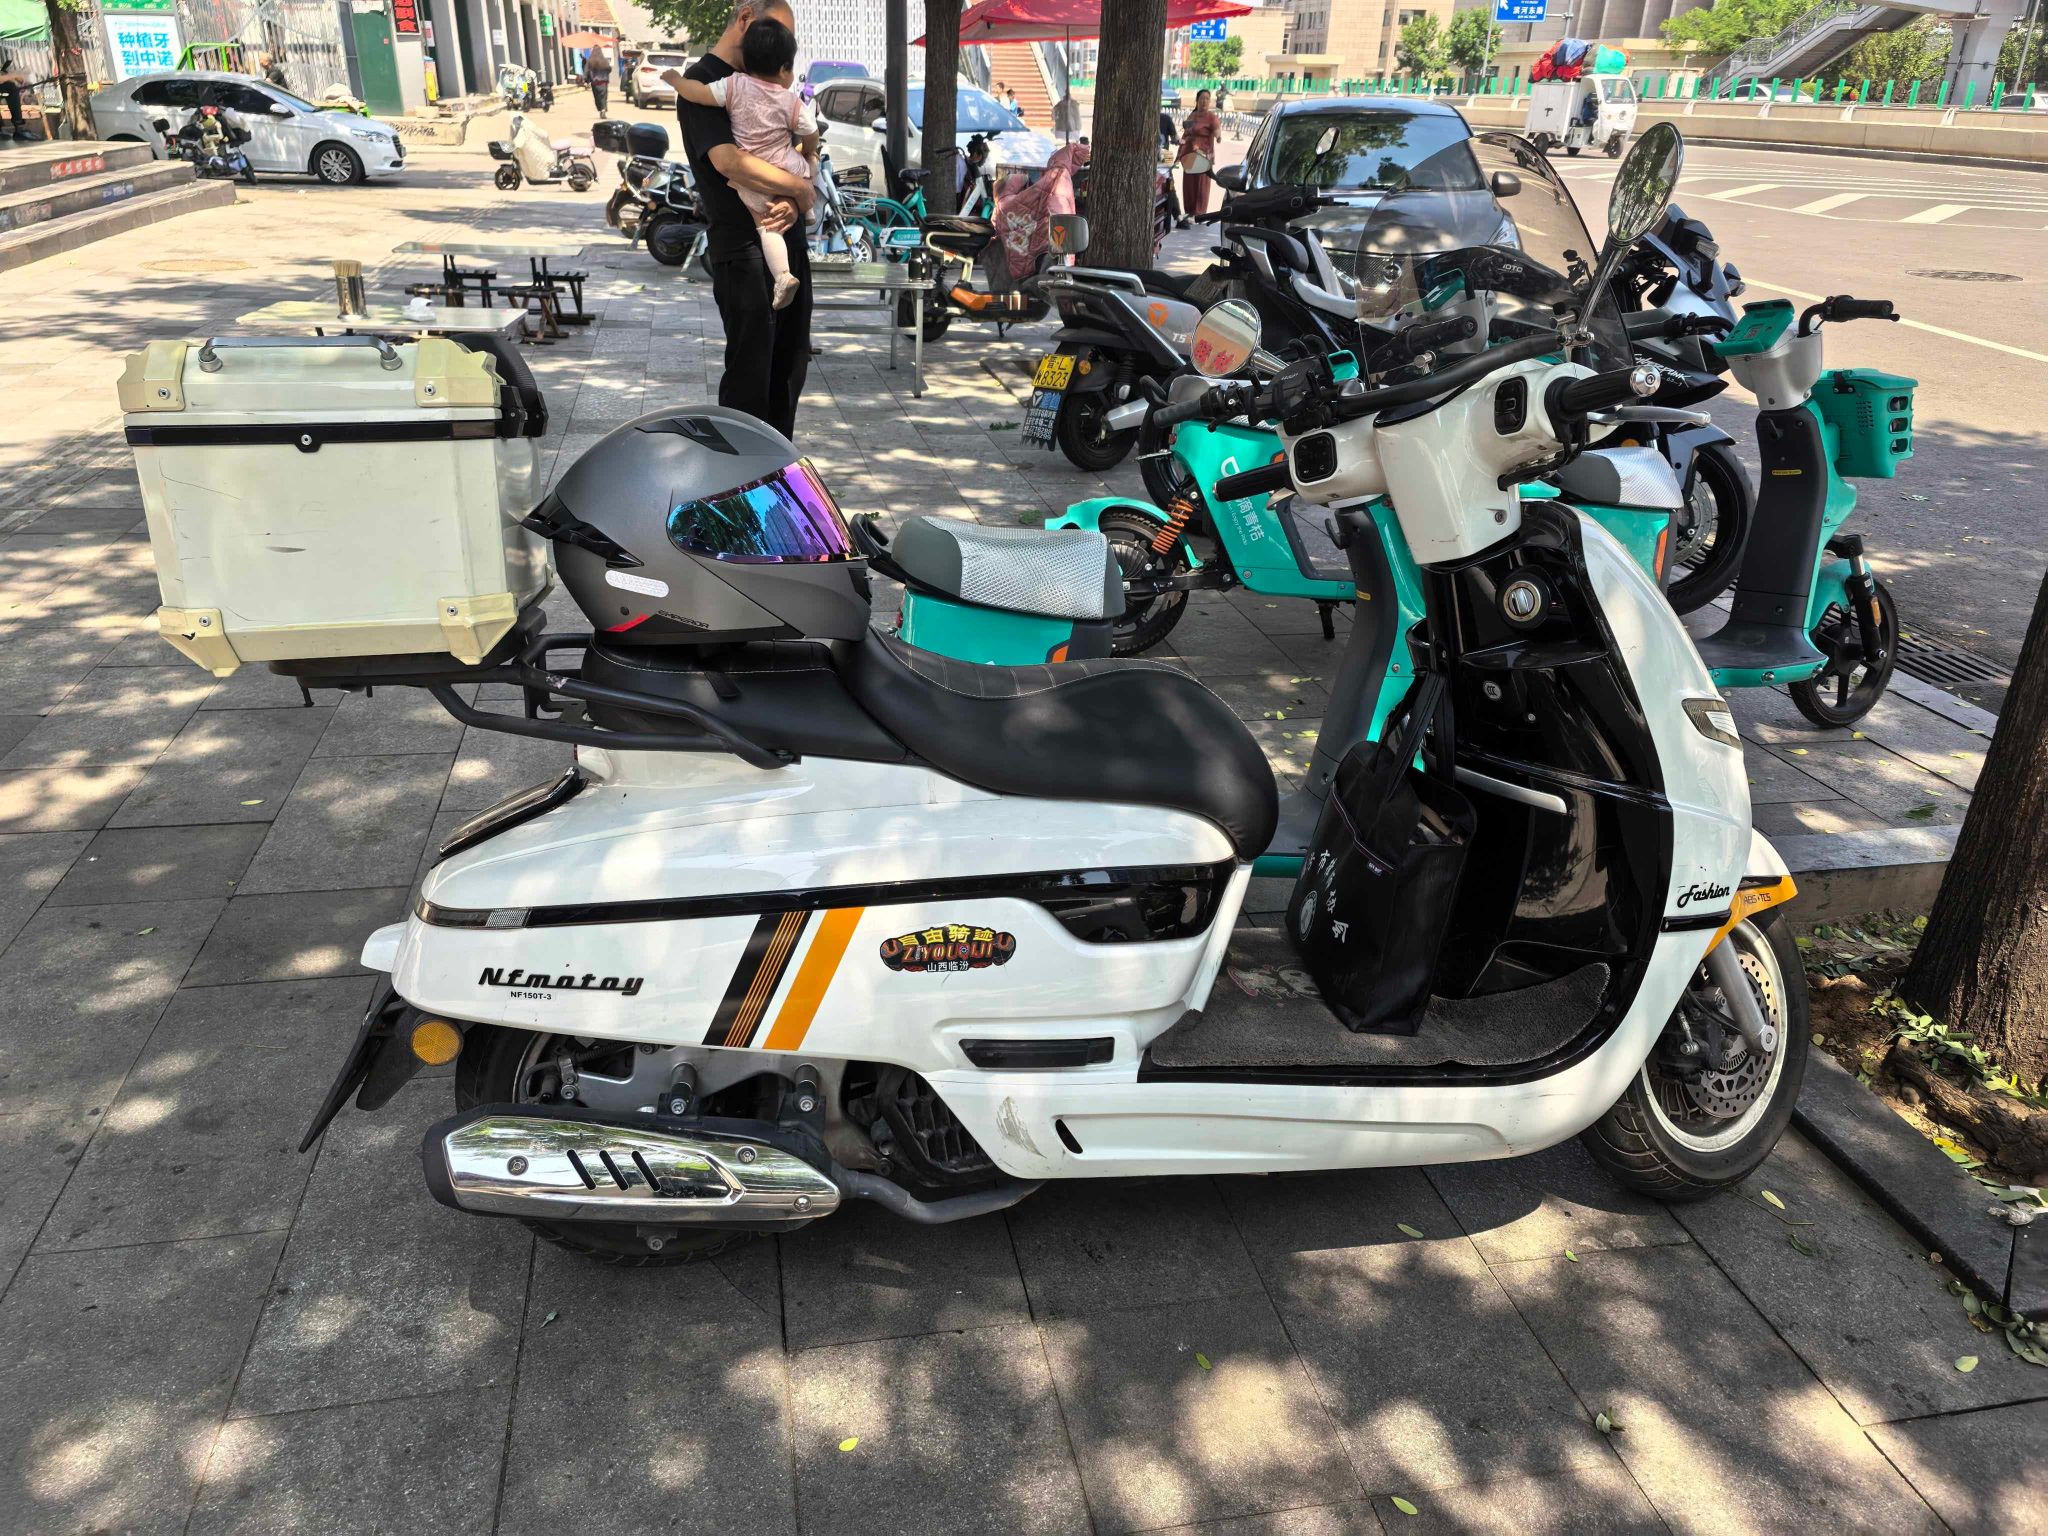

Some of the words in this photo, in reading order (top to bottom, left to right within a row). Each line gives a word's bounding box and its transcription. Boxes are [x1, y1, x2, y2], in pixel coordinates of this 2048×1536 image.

[1513, 6, 1544, 15] 滨河东路
[117, 32, 170, 48] 种植牙
[121, 50, 174, 66] 到中诺
[1677, 883, 1730, 908] Fashion
[898, 925, 996, 945] 自由骑迹
[927, 960, 969, 972] 山西临汾
[510, 991, 552, 1000] NF150T-3
